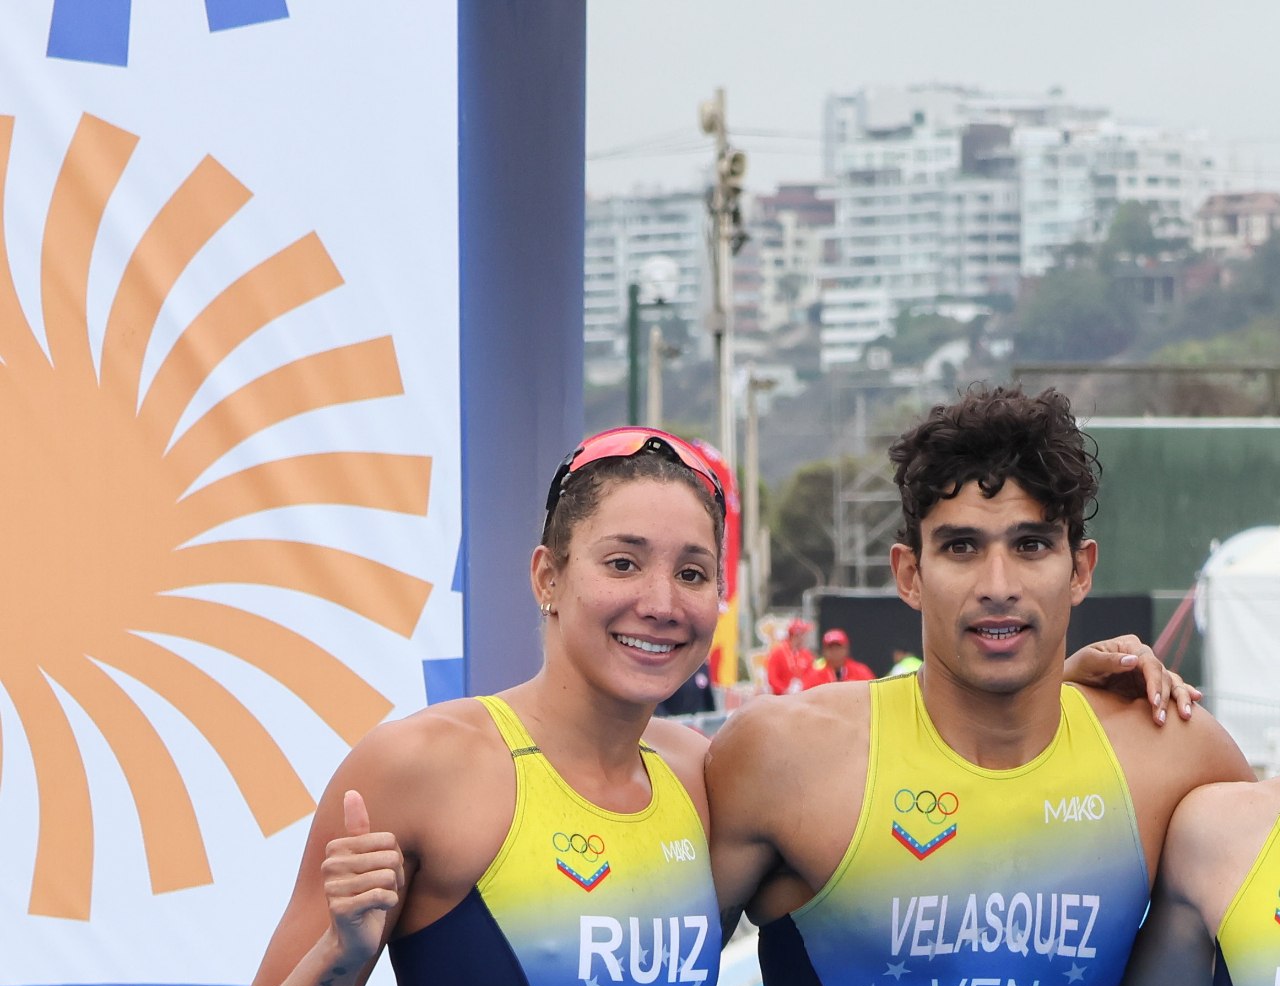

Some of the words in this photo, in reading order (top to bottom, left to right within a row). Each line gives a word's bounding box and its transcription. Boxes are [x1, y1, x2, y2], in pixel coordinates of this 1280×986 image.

[1044, 794, 1105, 824] MAKO
[661, 838, 696, 863] MAKO
[891, 892, 1100, 958] VELASQUEZ
[578, 915, 709, 984] RUIZ
